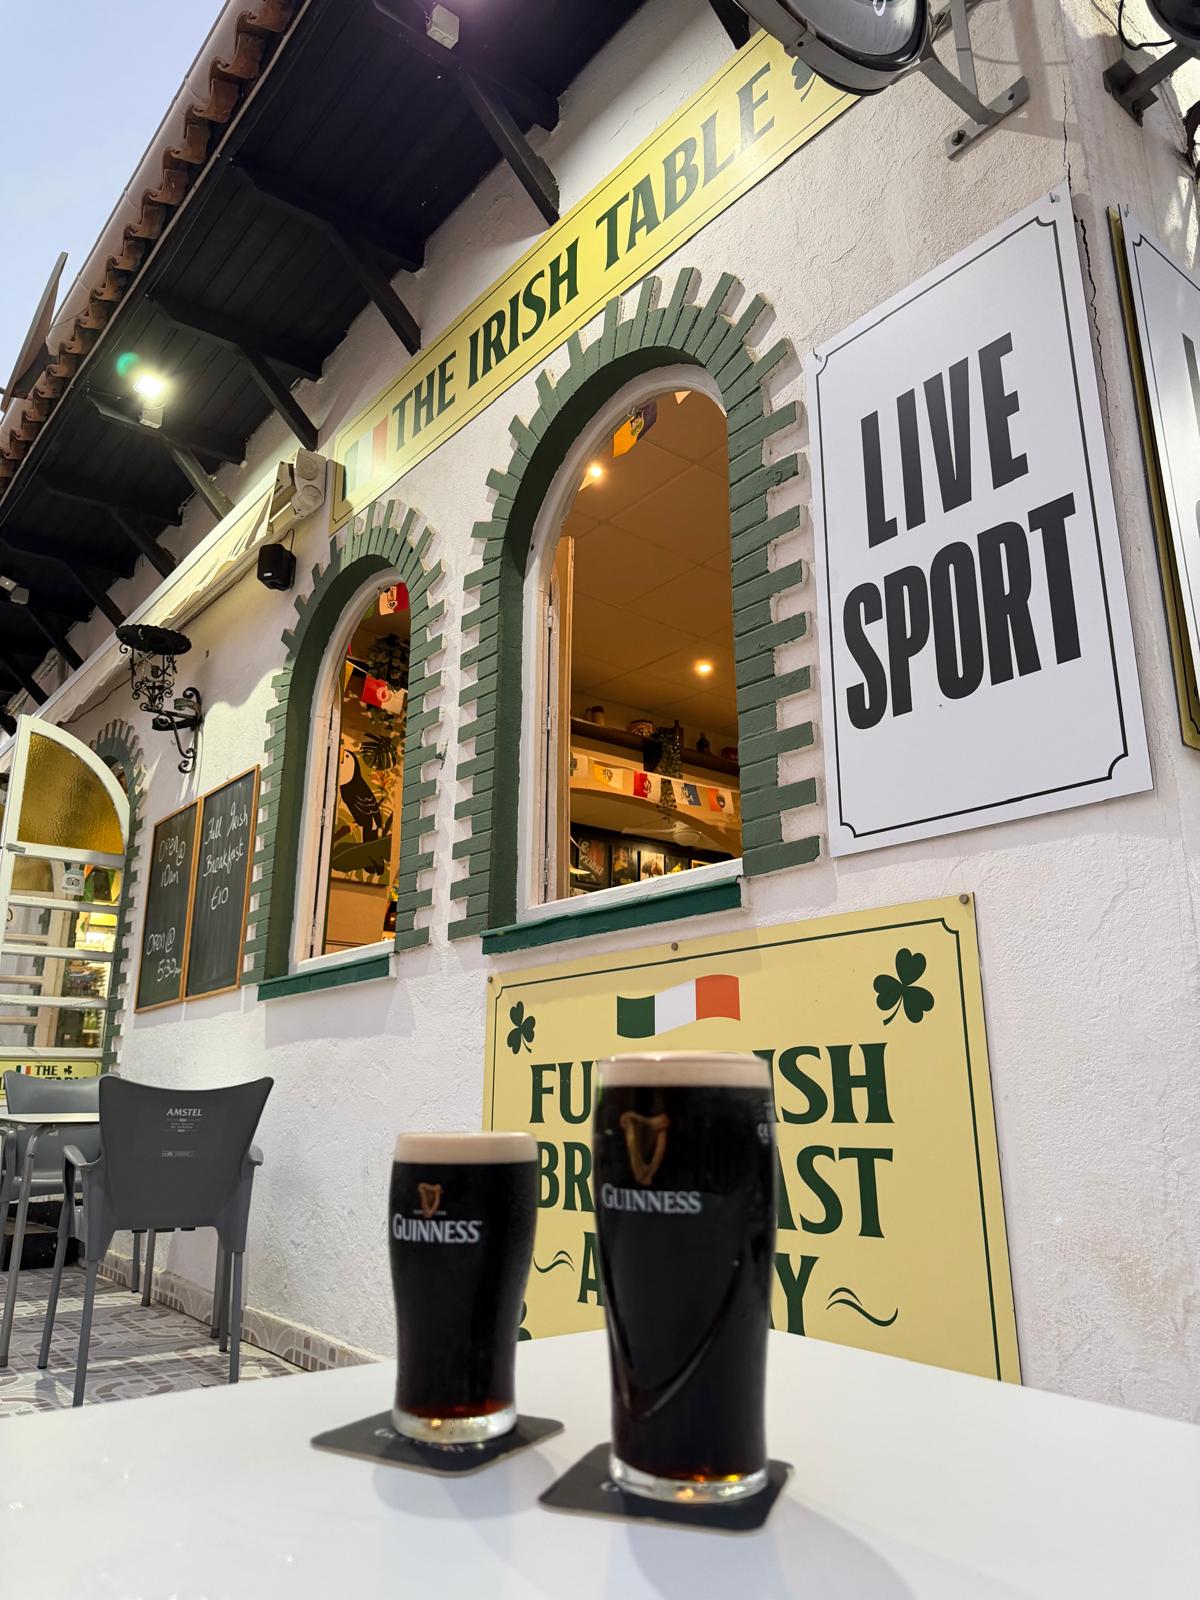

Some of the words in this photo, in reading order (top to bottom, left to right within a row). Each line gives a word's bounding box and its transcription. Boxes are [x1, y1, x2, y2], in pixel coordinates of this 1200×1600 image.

[392, 352, 456, 452] THE
[468, 237, 579, 390] IRISH
[596, 62, 775, 272] TABLE
[861, 332, 1029, 549] LIVE
[843, 492, 1081, 730] SPORT
[35, 1065, 58, 1076] THE
[529, 1060, 601, 1125] FU
[166, 1108, 203, 1117] AMSTEL
[601, 1183, 702, 1214] GUINNESS
[393, 1213, 481, 1243] GUINNESS
